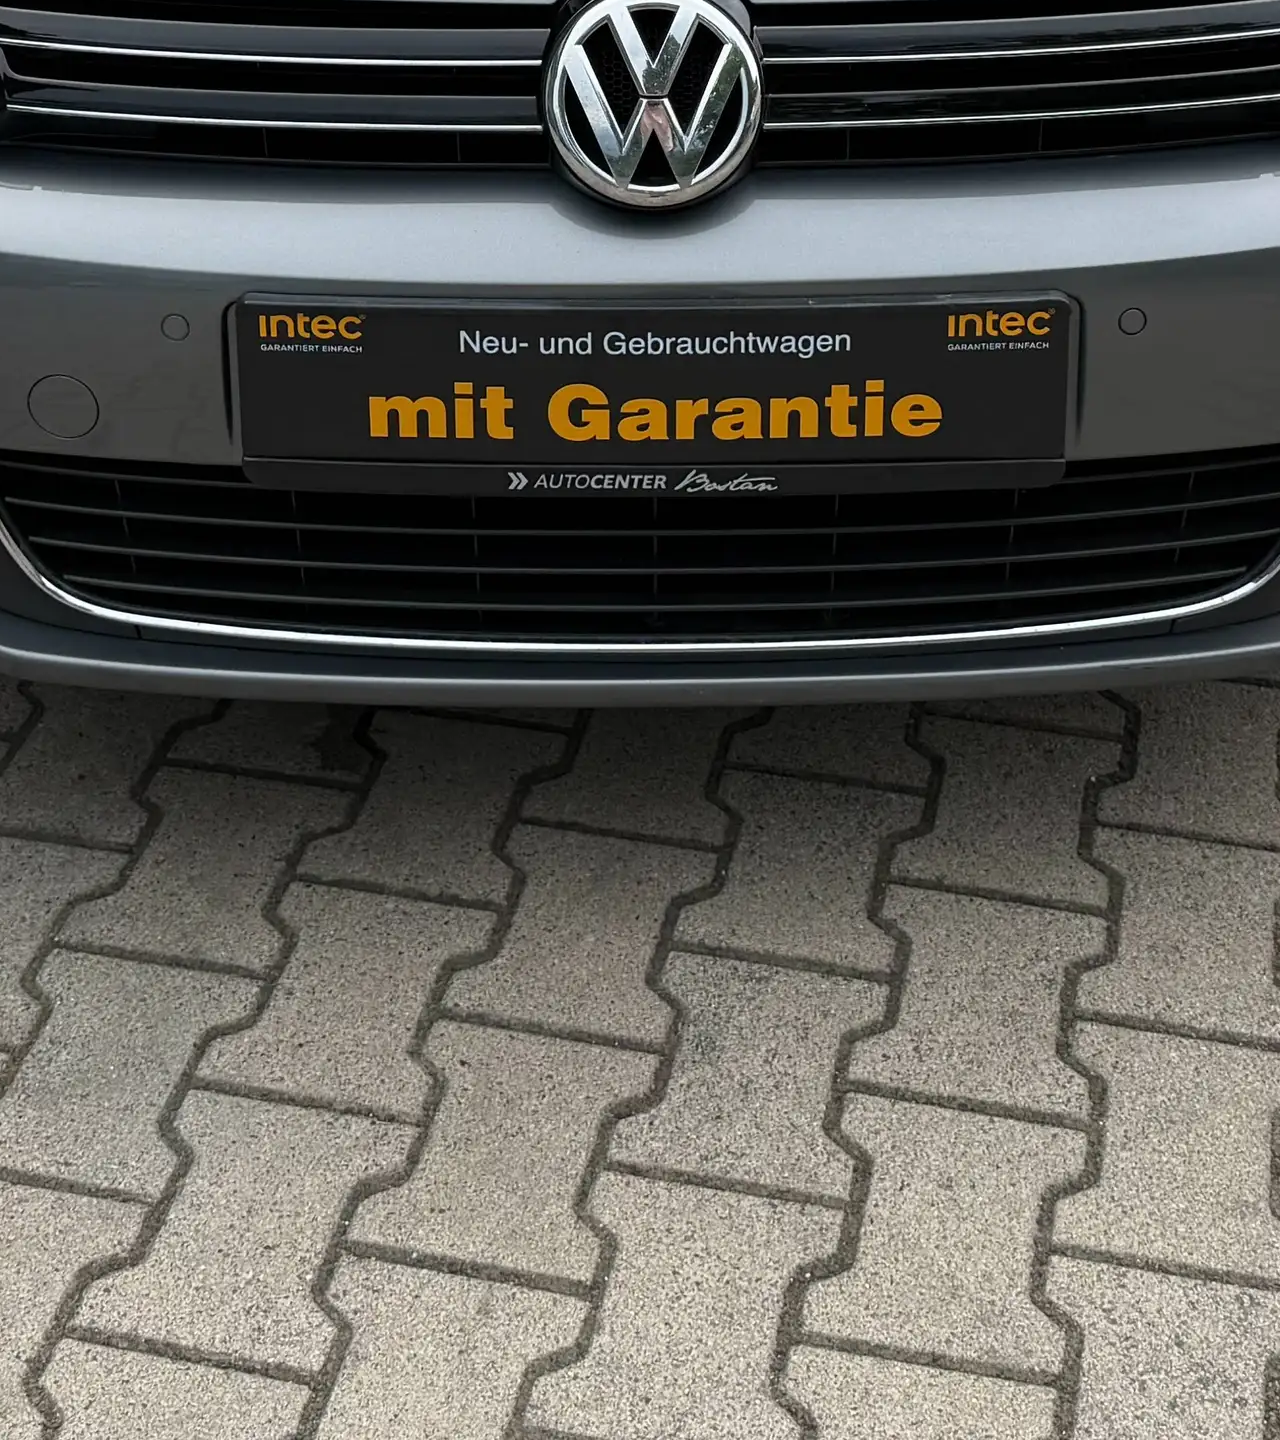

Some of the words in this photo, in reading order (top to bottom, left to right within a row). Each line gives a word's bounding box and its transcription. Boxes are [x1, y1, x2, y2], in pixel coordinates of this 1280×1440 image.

[260, 343, 320, 353] GARANTIERT
[322, 345, 363, 354] EINFACH
[459, 330, 529, 354] Neu-
[539, 332, 592, 355] und
[603, 331, 852, 359] Gebrauchtwagen
[947, 342, 1007, 352] GARANTIERT
[1008, 341, 1050, 350] EINFACH
[368, 381, 514, 440] mit
[547, 379, 943, 442] Garantie
[533, 473, 667, 490] AUTOCENTER
